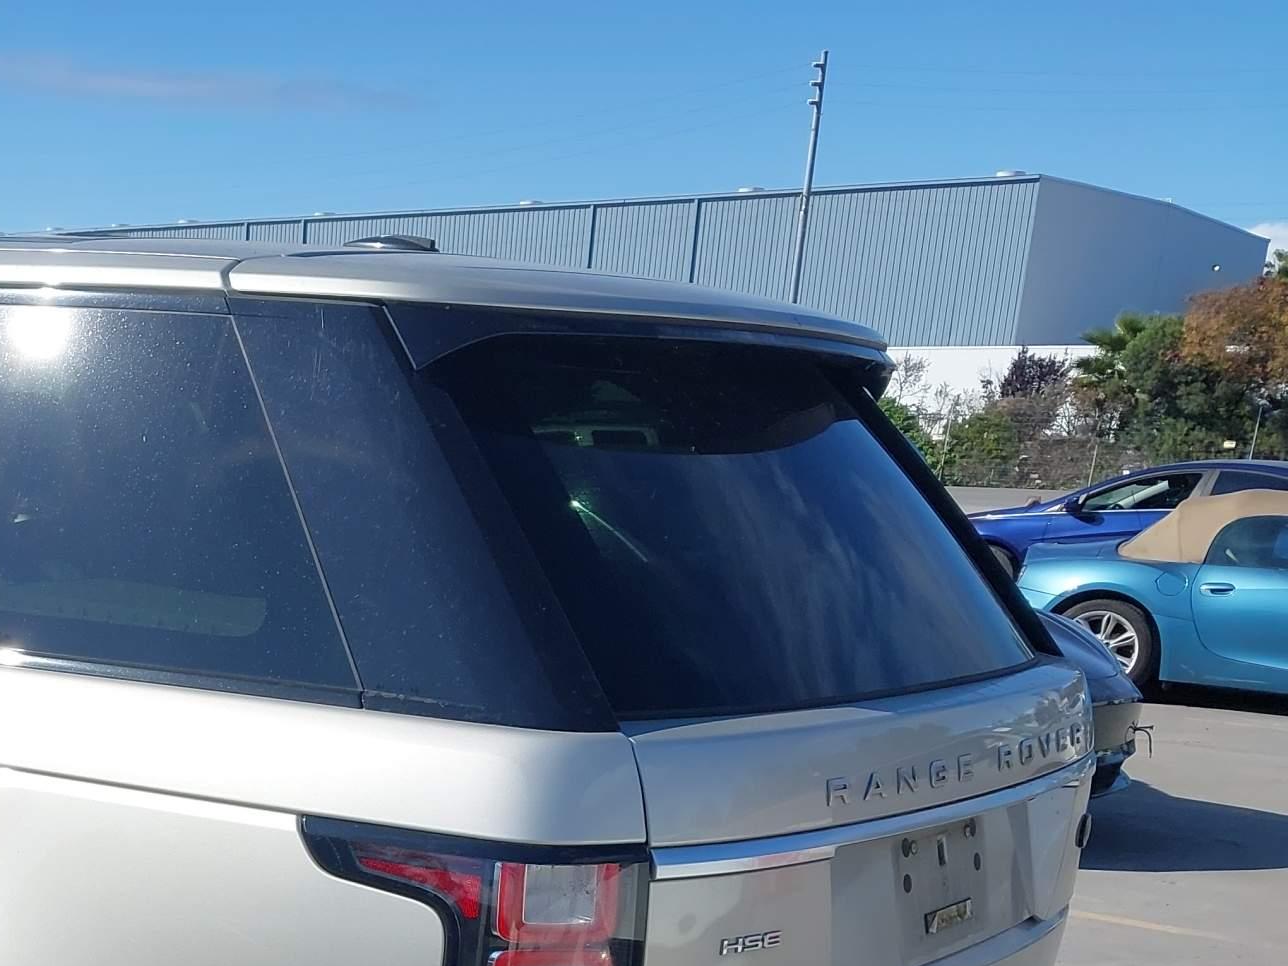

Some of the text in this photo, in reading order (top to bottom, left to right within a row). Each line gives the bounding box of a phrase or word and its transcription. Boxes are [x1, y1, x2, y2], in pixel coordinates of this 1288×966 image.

[825, 722, 1085, 808] RANGE ROVER
[719, 930, 783, 956] HSE
